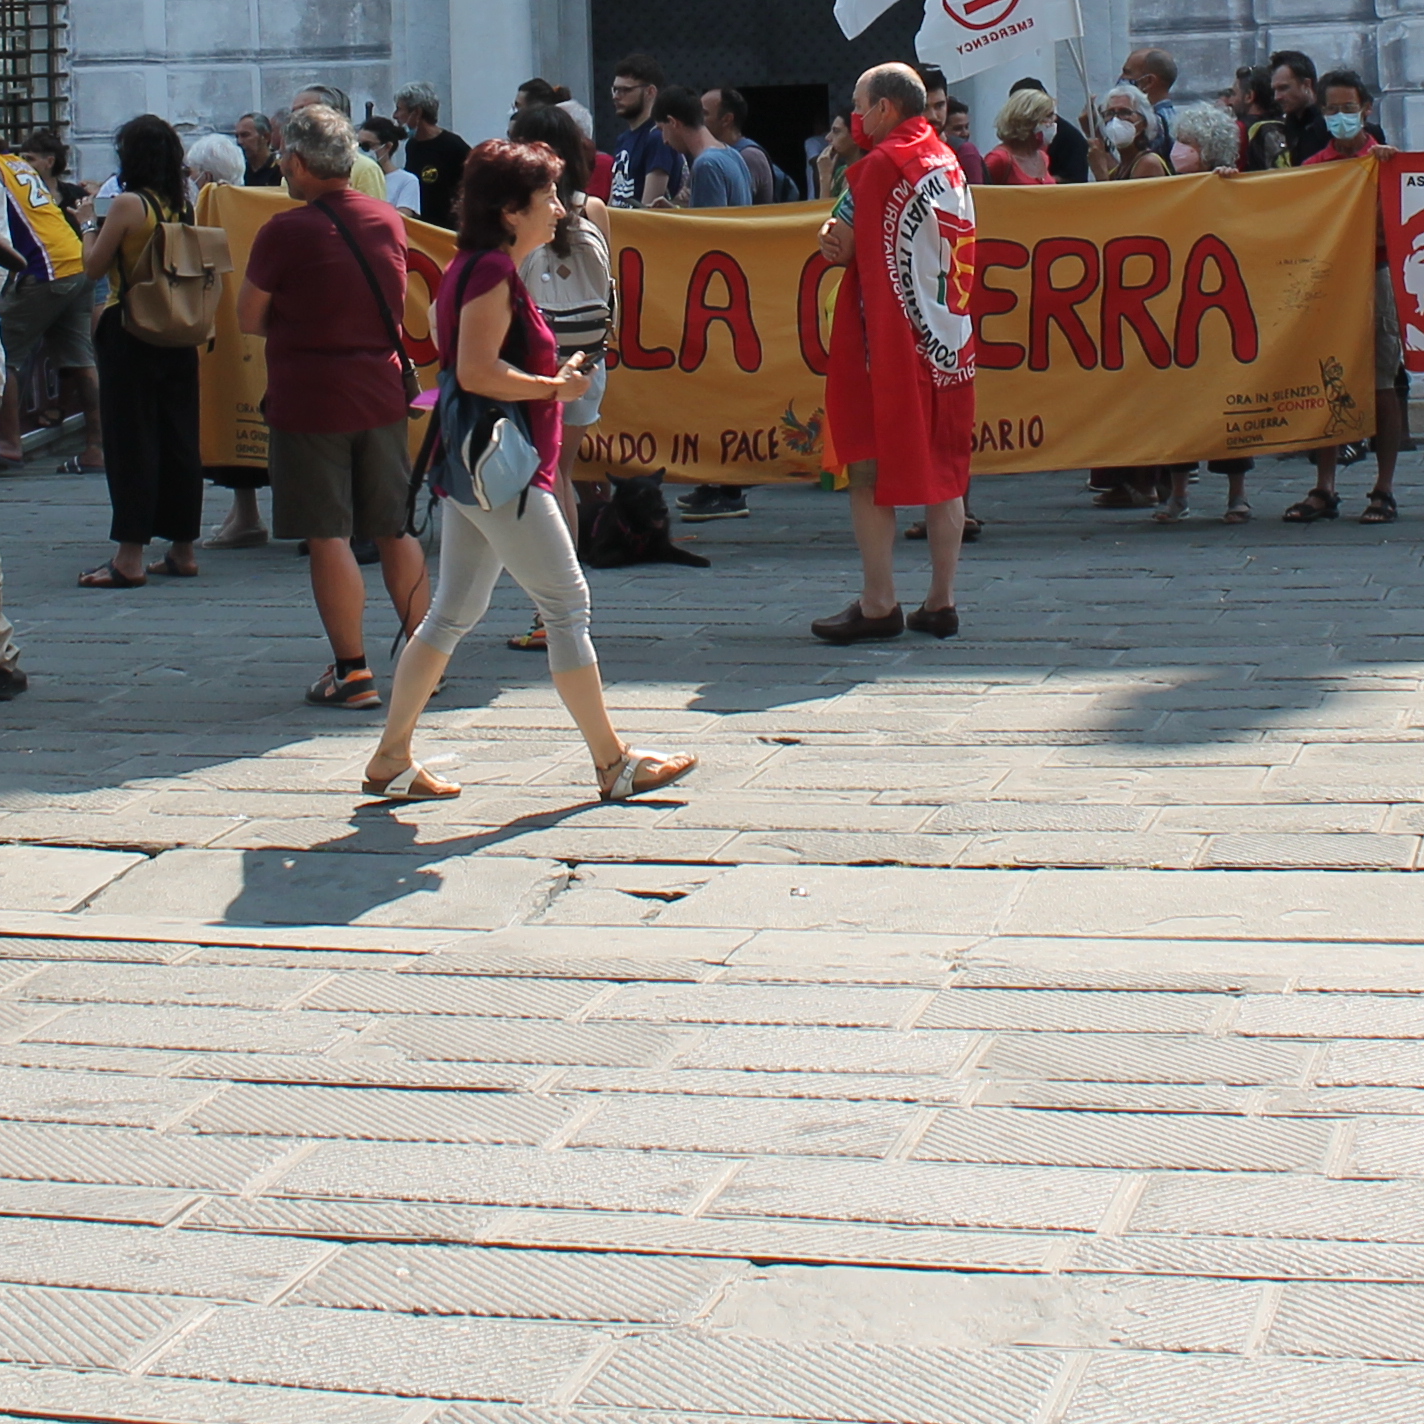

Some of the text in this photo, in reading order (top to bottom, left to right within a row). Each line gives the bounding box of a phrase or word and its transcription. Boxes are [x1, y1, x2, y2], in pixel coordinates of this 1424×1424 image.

[1226, 385, 1320, 406] ORA IN SILENZIO
[1277, 398, 1325, 413] CONTRO
[1226, 417, 1288, 433] LA GUERRA
[578, 431, 657, 465] ONDO
[671, 433, 699, 465] IN
[720, 426, 779, 465] PACE
